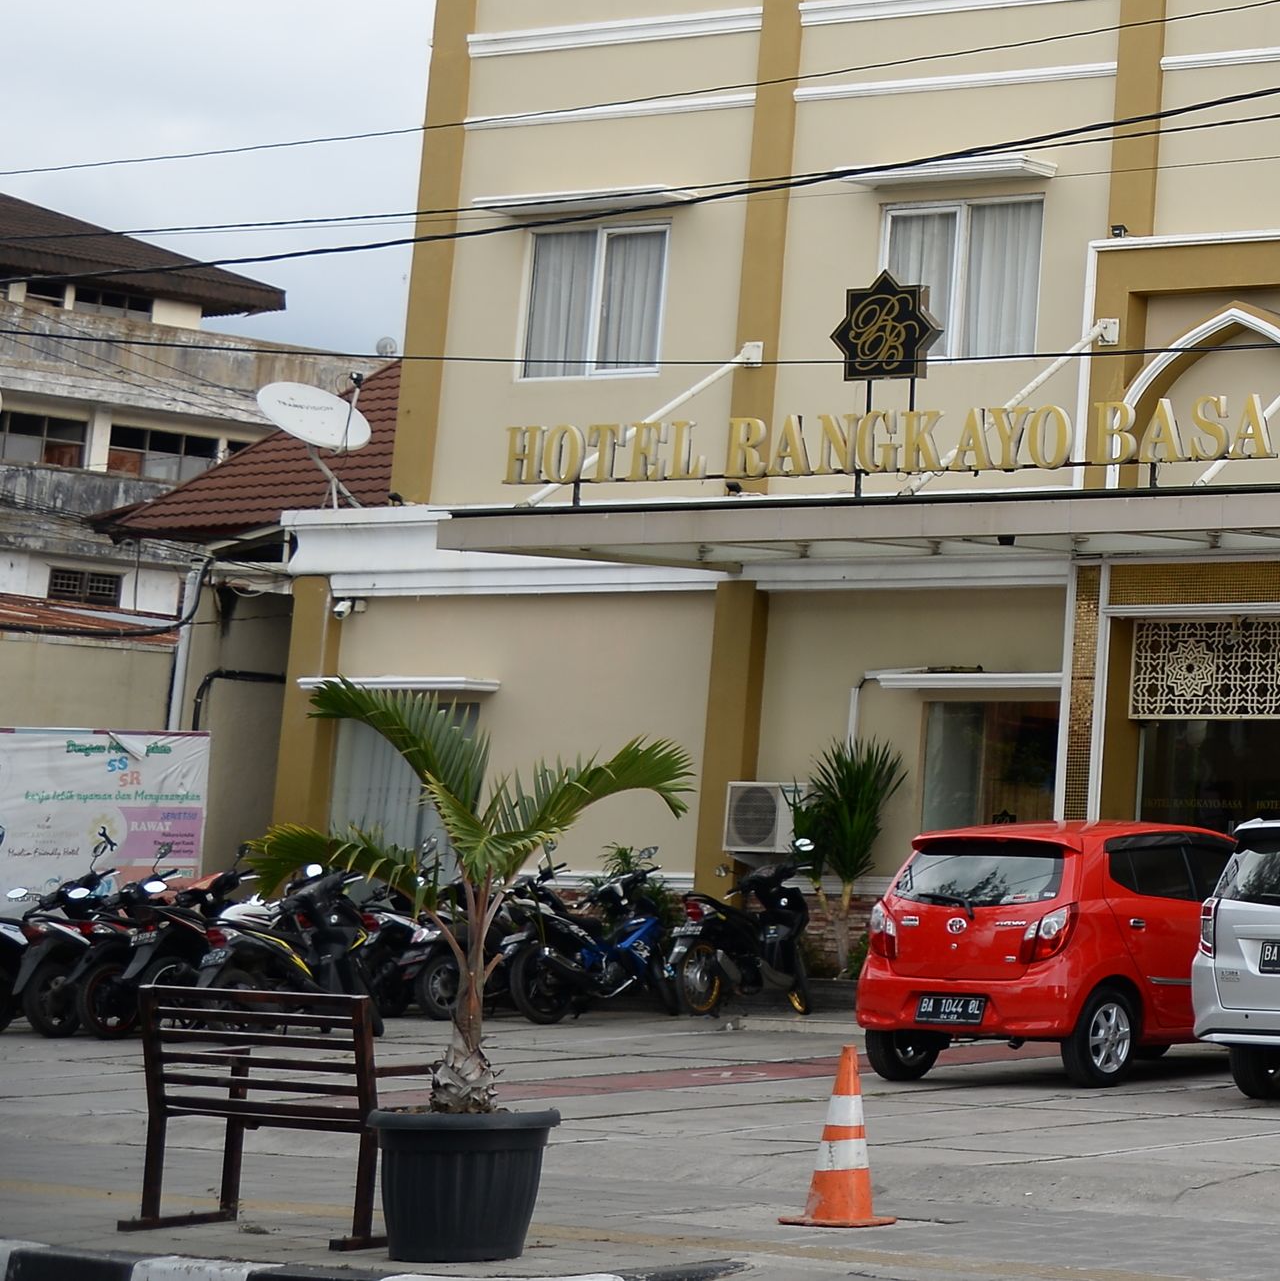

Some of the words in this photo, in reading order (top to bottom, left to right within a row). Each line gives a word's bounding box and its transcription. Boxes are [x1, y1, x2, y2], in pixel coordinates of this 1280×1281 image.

[502, 420, 706, 485] HOTEL
[723, 405, 1074, 479] RANGKAYO
[1092, 393, 1278, 466] BASA
[115, 791, 131, 800] dan
[1144, 798, 1169, 809] HOTEL
[1170, 798, 1221, 809] RANGKAYO
[1222, 799, 1243, 809] BASA
[130, 821, 172, 832] RAWAT
[63, 847, 80, 856] Hotel
[1264, 946, 1278, 961] BA
[920, 998, 934, 1012] BA
[940, 999, 964, 1013] 1044
